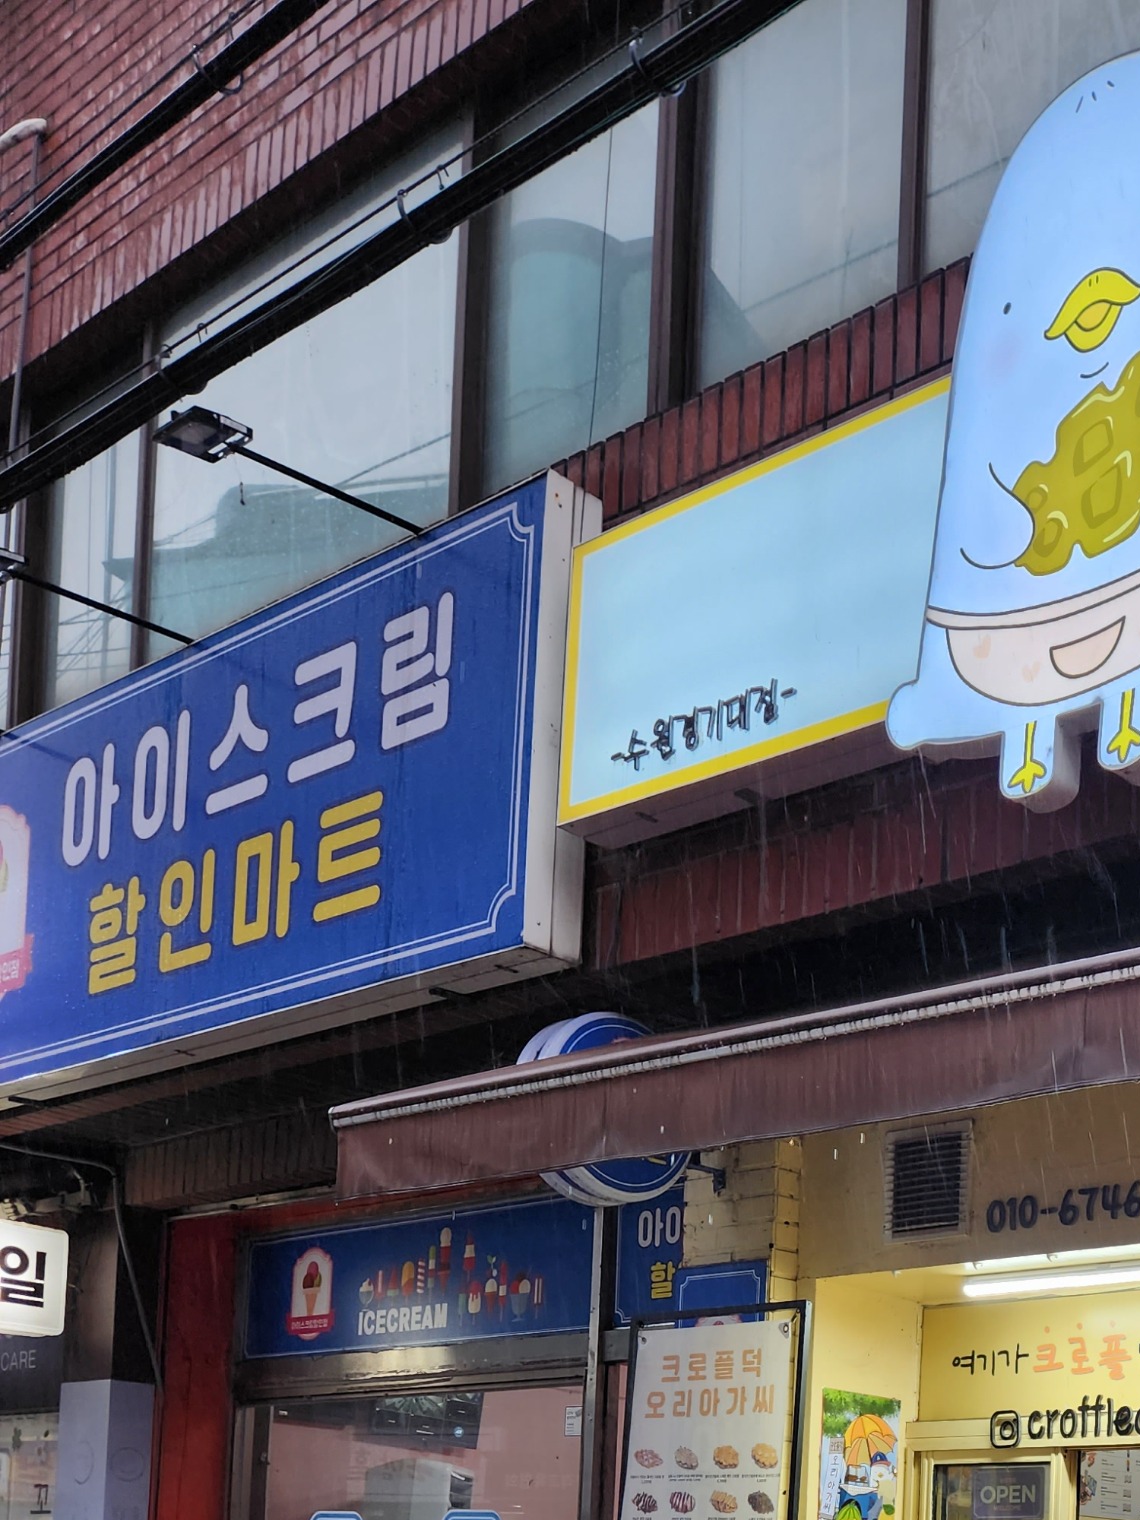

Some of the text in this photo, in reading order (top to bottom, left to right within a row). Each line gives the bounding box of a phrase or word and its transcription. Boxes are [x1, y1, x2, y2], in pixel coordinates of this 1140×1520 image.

[62, 592, 454, 867] 아이스크림
[88, 791, 383, 995] 할인마트
[358, 1302, 448, 1336] ICECREAM
[1, 1349, 36, 1371] CARE
[661, 1348, 762, 1384] 크로플덕
[952, 1343, 1029, 1376] 여기가
[1033, 1334, 1132, 1380] 크로플
[644, 1384, 775, 1420] 오리아가씨
[980, 1484, 1036, 1505] OPEN
